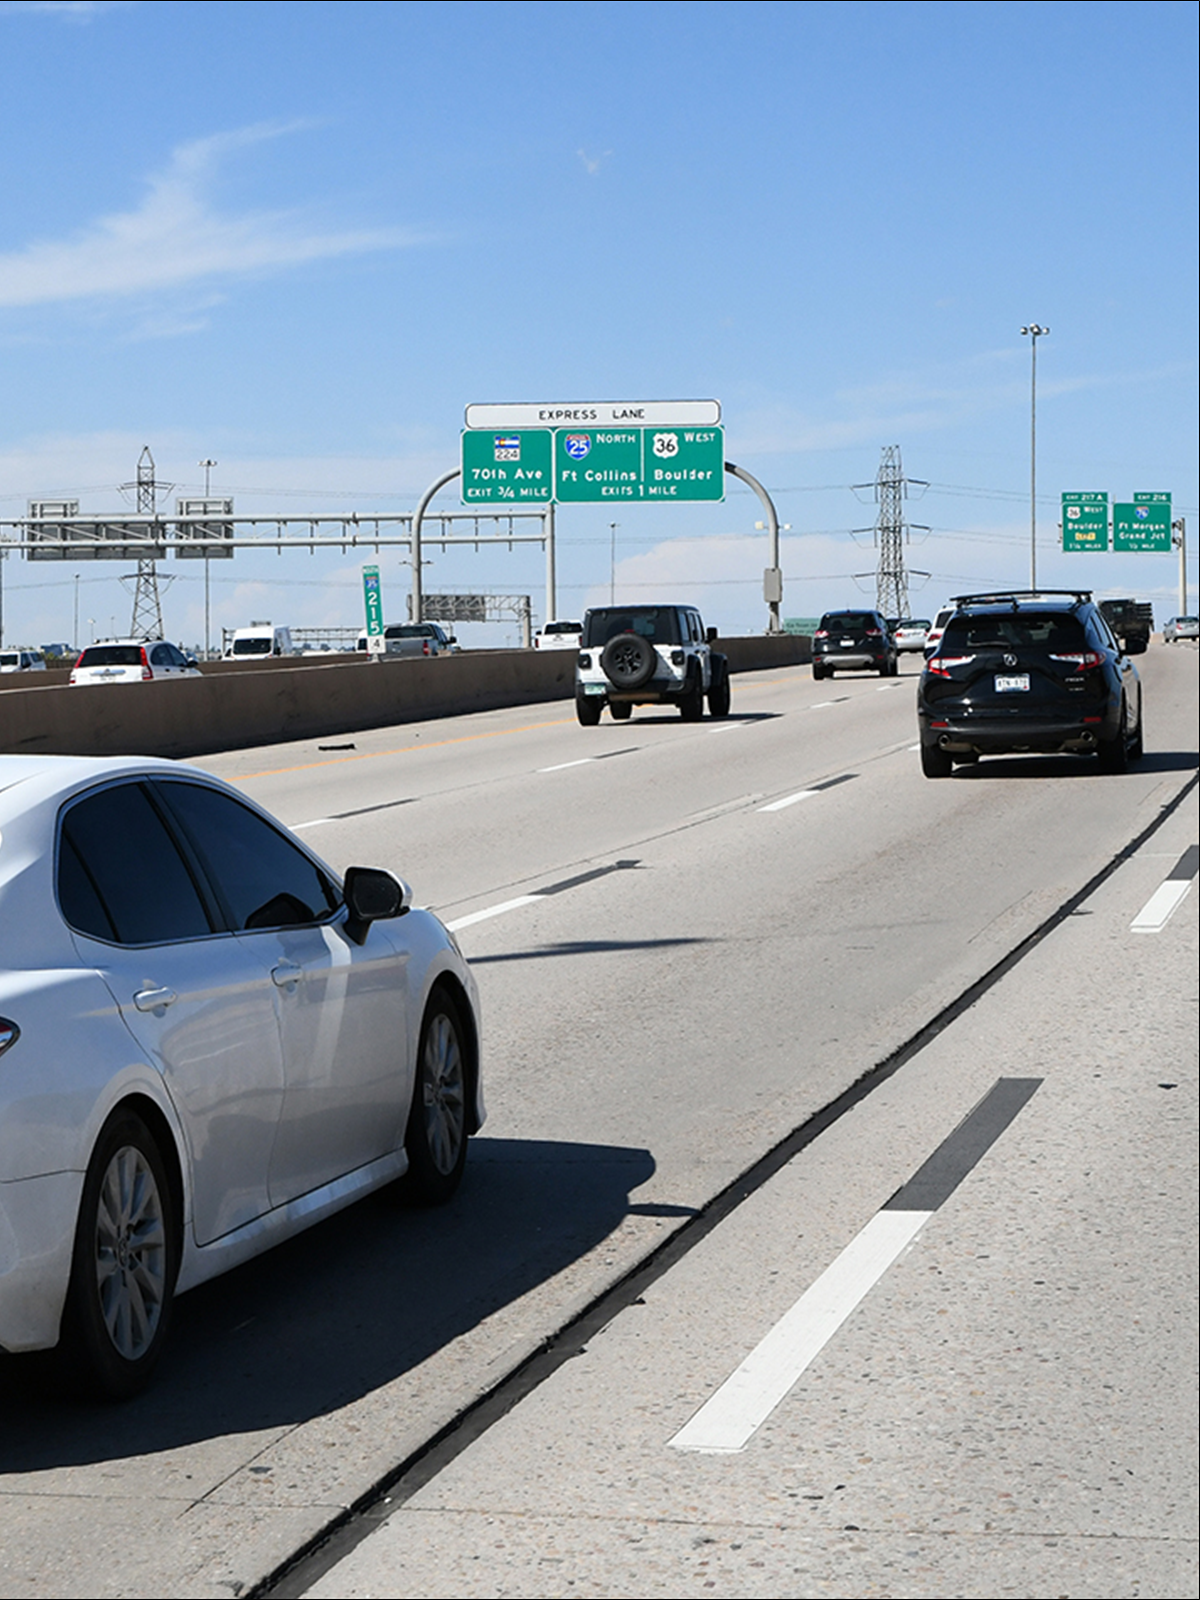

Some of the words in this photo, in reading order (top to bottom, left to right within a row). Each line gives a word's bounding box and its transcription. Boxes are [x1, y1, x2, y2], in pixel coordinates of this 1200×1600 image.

[538, 409, 598, 421] EXPRESS
[612, 408, 645, 420] LANE
[596, 433, 636, 444] NORTH
[684, 432, 716, 443] WEST
[569, 439, 588, 455] 25
[655, 438, 676, 453] 36
[495, 448, 519, 460] 224
[471, 468, 507, 480] 70th
[513, 467, 543, 480] Ave
[561, 470, 577, 482] Ft
[584, 469, 638, 482] Collins
[654, 469, 713, 481] Boulder
[467, 487, 493, 498] EXIT
[520, 486, 549, 497] MILE
[601, 486, 633, 497] EXITS
[638, 484, 644, 497] 1
[649, 485, 678, 496] MILE
[1068, 522, 1103, 530] Boulder
[1133, 522, 1165, 531] Morgan
[1119, 531, 1146, 540] Grand
[368, 592, 380, 634] 215
